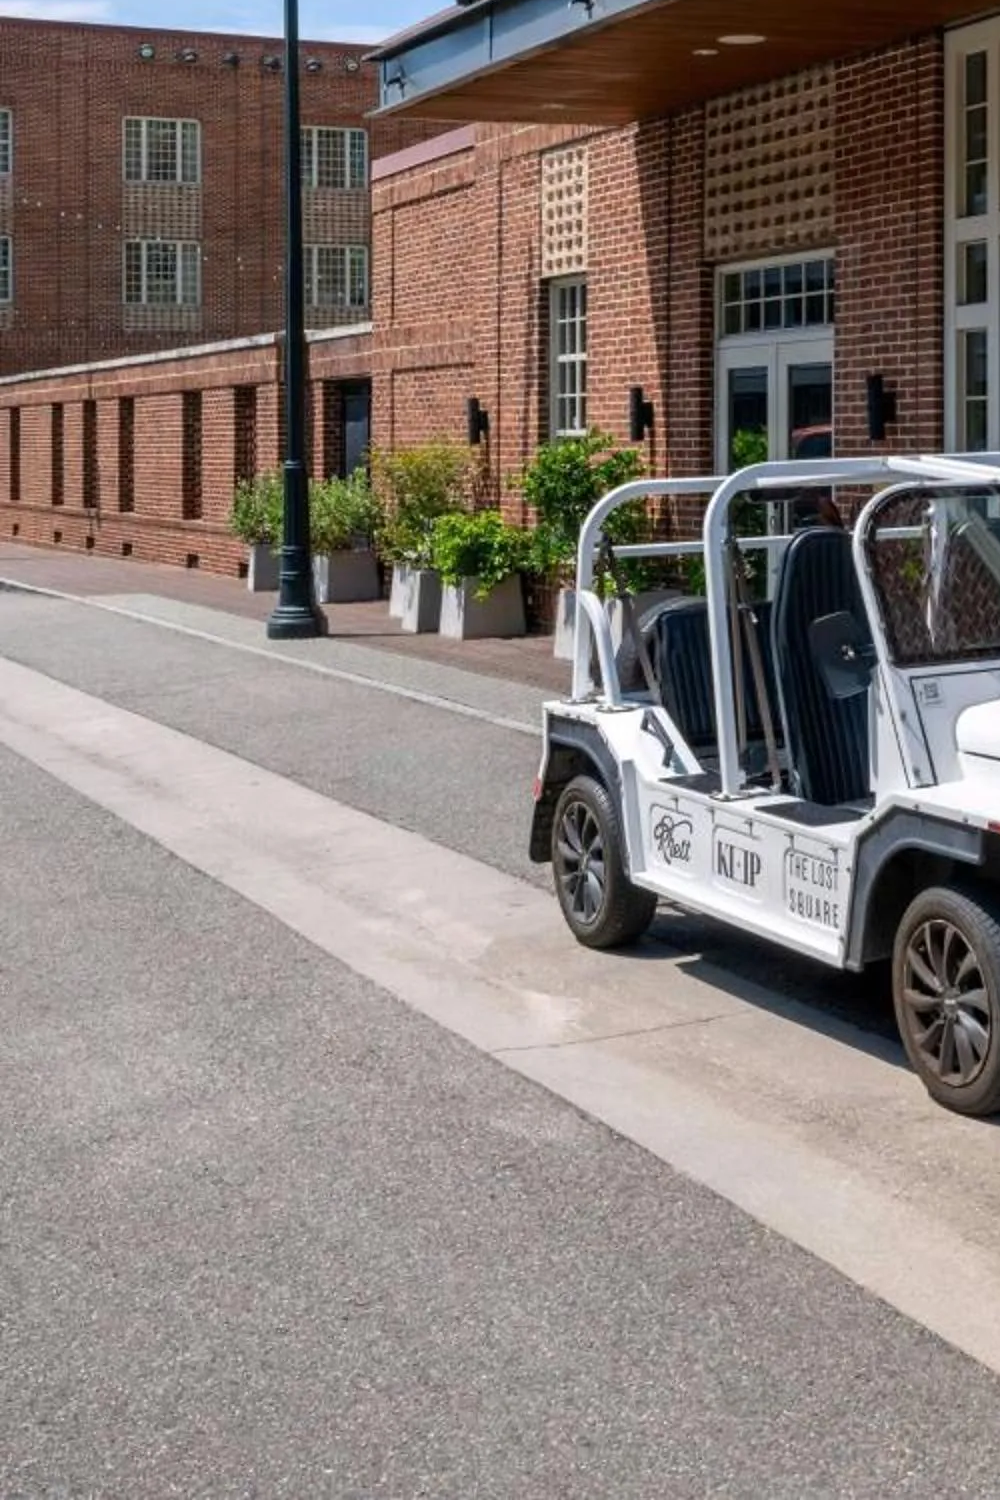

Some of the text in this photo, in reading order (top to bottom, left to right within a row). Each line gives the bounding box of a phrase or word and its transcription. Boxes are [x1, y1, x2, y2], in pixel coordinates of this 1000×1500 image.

[789, 853, 839, 891] THE LOST
[789, 887, 840, 929] SQUARE
